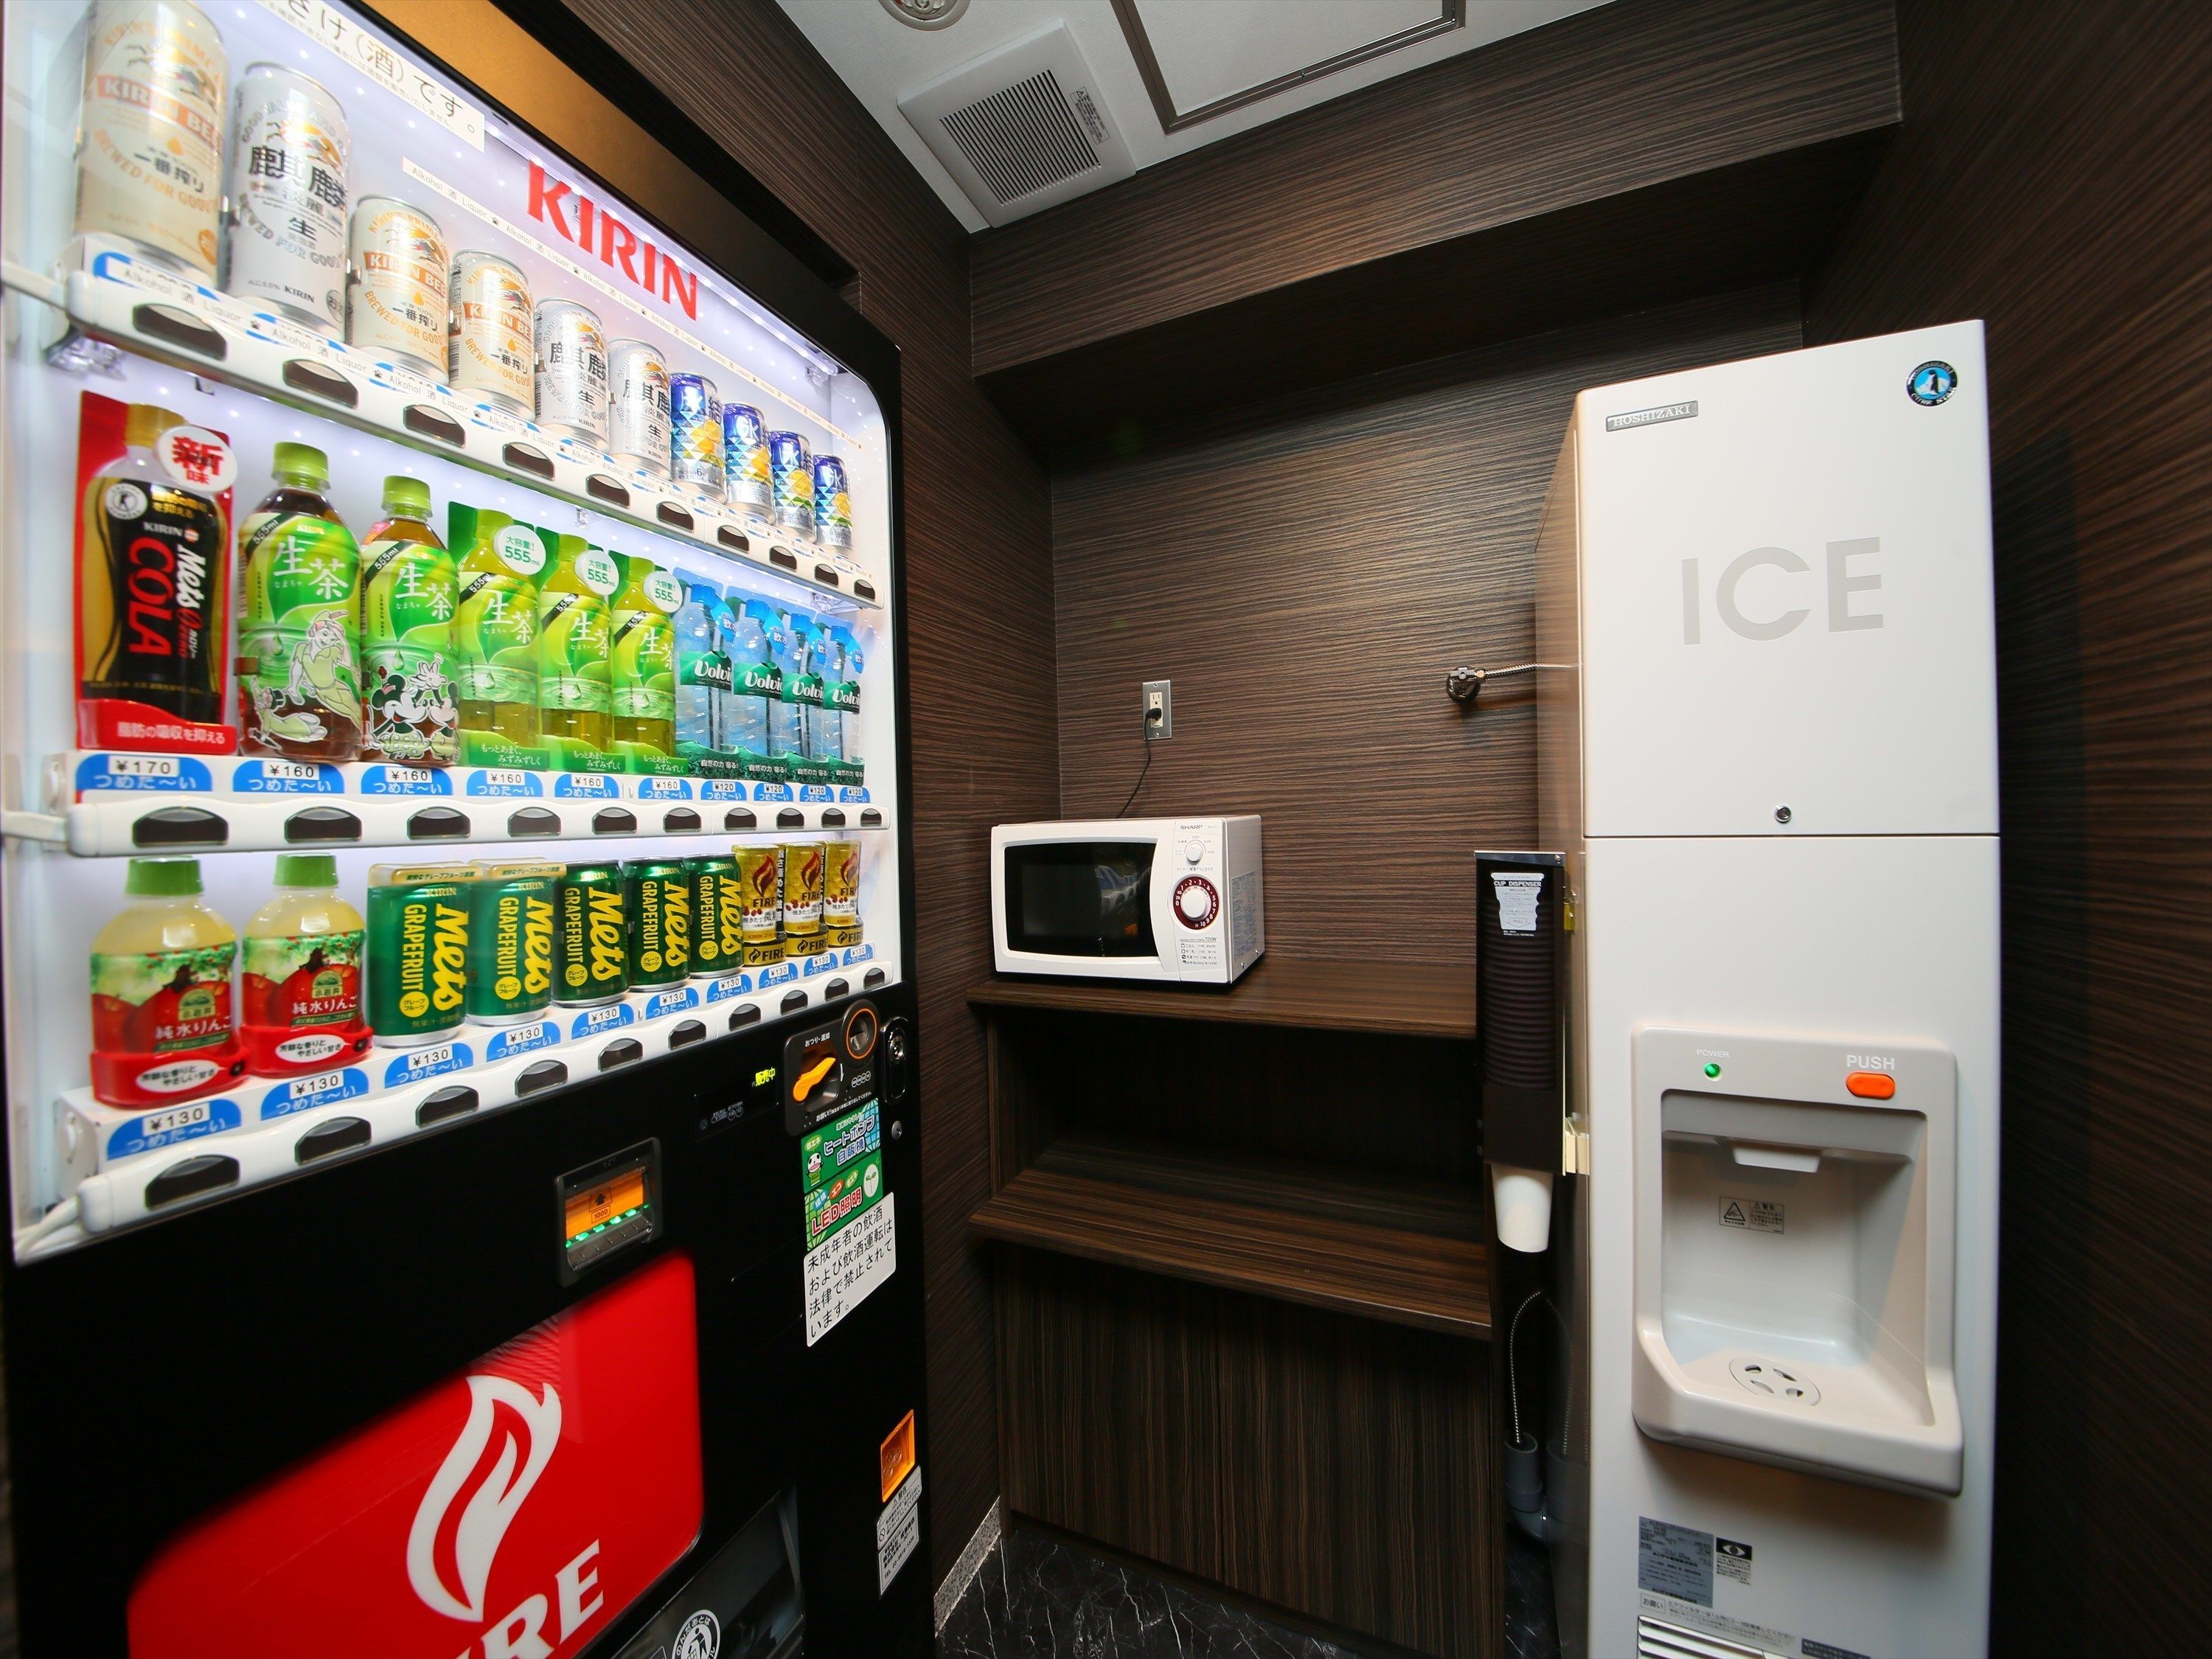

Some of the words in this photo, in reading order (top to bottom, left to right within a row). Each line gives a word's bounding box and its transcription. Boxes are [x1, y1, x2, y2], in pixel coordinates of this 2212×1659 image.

[412, 167, 443, 191] Alkohol
[462, 198, 487, 218] Liquor
[507, 225, 532, 246] Alkohol
[288, 217, 317, 242] 生
[527, 160, 698, 321] KIRIN
[285, 285, 315, 303] KIRIN
[392, 306, 438, 331] 一番搾り
[272, 328, 311, 352] Alkohol
[389, 375, 421, 395] Alkohol
[442, 394, 468, 413] Liquor
[489, 415, 515, 433] Alkohol
[572, 449, 595, 465] Alkohol
[602, 462, 625, 477] Alkohol
[578, 389, 595, 406] 生
[579, 418, 596, 429] KIRIN
[1614, 404, 1691, 428] HOSHIZAKI
[648, 423, 662, 439] 生
[172, 437, 224, 476] 新
[144, 521, 183, 538] KIRIN
[274, 535, 349, 600] 生茶
[375, 547, 399, 569] 555ml
[128, 537, 175, 655] COLA
[395, 562, 453, 621] 生茶
[1682, 536, 1884, 646] ICE
[116, 760, 171, 774] ¥170
[270, 764, 315, 778] ¥160
[392, 771, 428, 781] ¥160
[490, 773, 522, 784] ¥160
[575, 776, 602, 787] ¥160
[655, 781, 678, 790] ¥160
[714, 783, 734, 791] ¥120
[765, 785, 782, 793] ¥120
[810, 787, 825, 795] ¥120
[581, 872, 608, 881] KIRIN
[657, 866, 680, 875] KIRIN
[713, 863, 734, 872] KIRIN
[425, 887, 456, 897] KIRIN
[518, 881, 544, 891] KIRIN
[641, 880, 658, 950] GRAPEFRUIT
[700, 875, 715, 940] GRAPEFRUIT
[719, 874, 742, 956] Mets
[565, 887, 583, 963] GRAPEFRUIT
[588, 886, 624, 981] Mets
[664, 880, 690, 967] Mets
[402, 903, 428, 991] GRAPEFRUIT
[497, 897, 519, 976] GRAPEFRUIT
[524, 896, 554, 995] Mets
[432, 903, 469, 1012] Mets
[762, 948, 785, 961] FIRE
[813, 955, 829, 965] ¥130
[851, 946, 865, 956] ¥130
[770, 966, 787, 976] ¥130
[721, 978, 740, 989] ¥130
[663, 992, 684, 1004] ¥130
[591, 1008, 618, 1023] ¥130
[509, 1027, 540, 1043] ¥130
[413, 1049, 449, 1067] ¥130
[1697, 1048, 1730, 1058] POWER
[1846, 1054, 1895, 1071] PUSH
[295, 1074, 339, 1095] ¥130
[150, 1107, 204, 1131] ¥130
[824, 1114, 875, 1157] ヒートポンプ
[837, 1136, 866, 1166] 自販機
[812, 1186, 863, 1237] LED照明
[807, 1204, 883, 1274] 未成年者の飲酒
[809, 1218, 893, 1295] および飲酒運転は
[809, 1243, 892, 1318] 法律で禁止されて
[811, 1298, 850, 1338] います。
